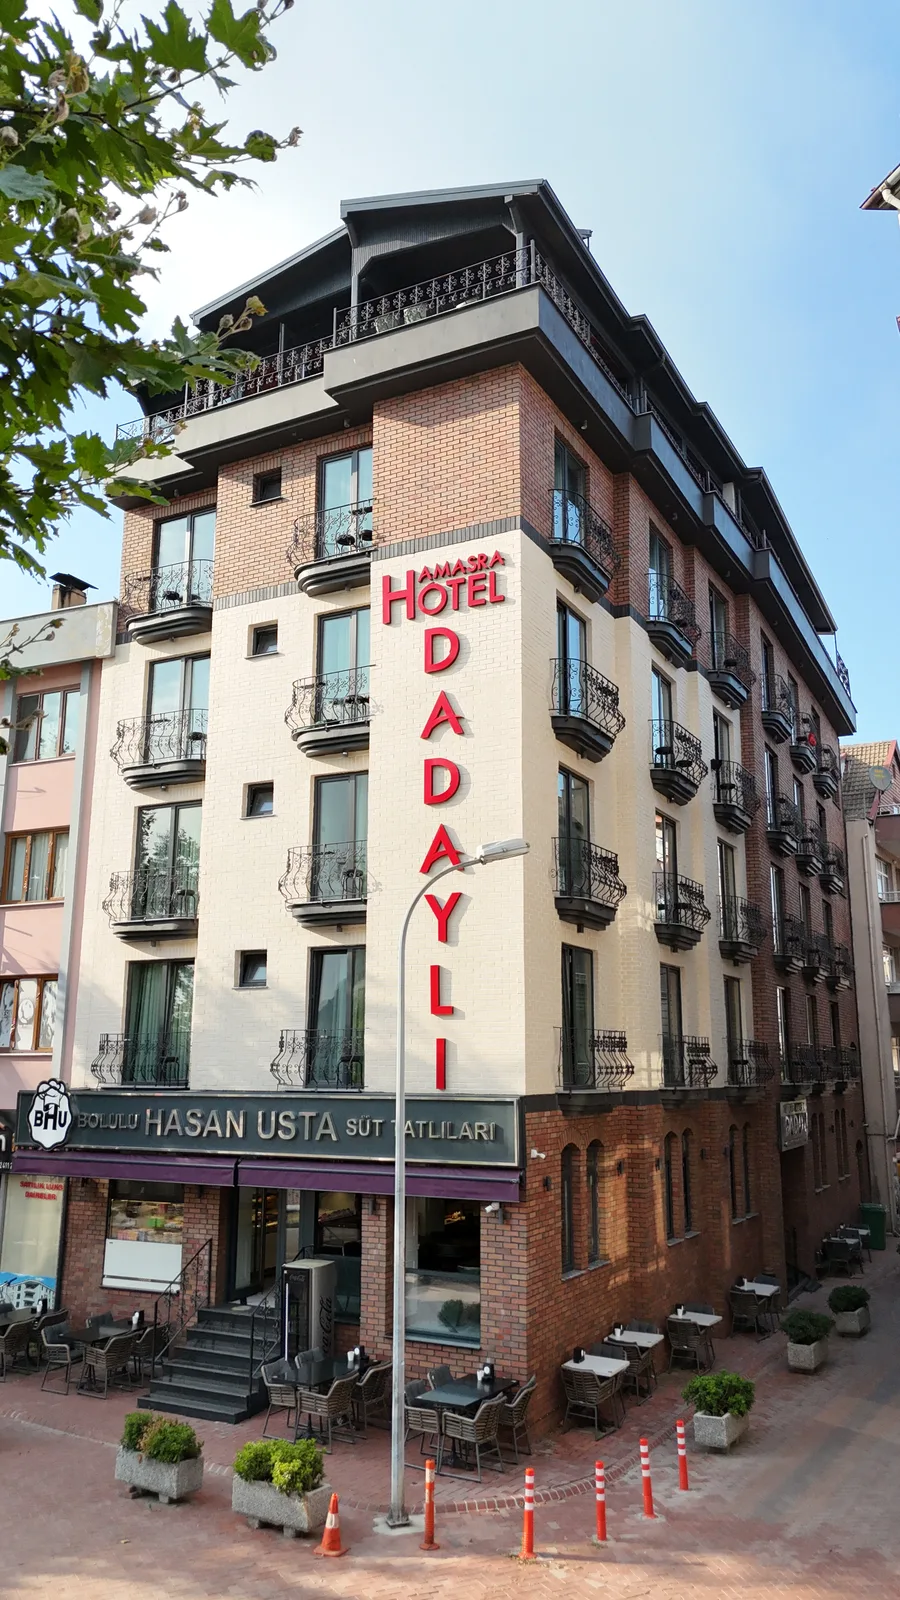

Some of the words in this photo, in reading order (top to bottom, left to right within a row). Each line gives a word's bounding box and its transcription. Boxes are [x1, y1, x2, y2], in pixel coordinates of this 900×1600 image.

[418, 550, 505, 583] AMASRA
[382, 569, 505, 625] HOTEL
[420, 627, 463, 1090] DADAYLI
[34, 1103, 68, 1130] BHU
[77, 1112, 140, 1130] BOLULU
[144, 1108, 247, 1139] HASAN
[257, 1110, 339, 1142] USTA
[346, 1115, 385, 1137] SÜT
